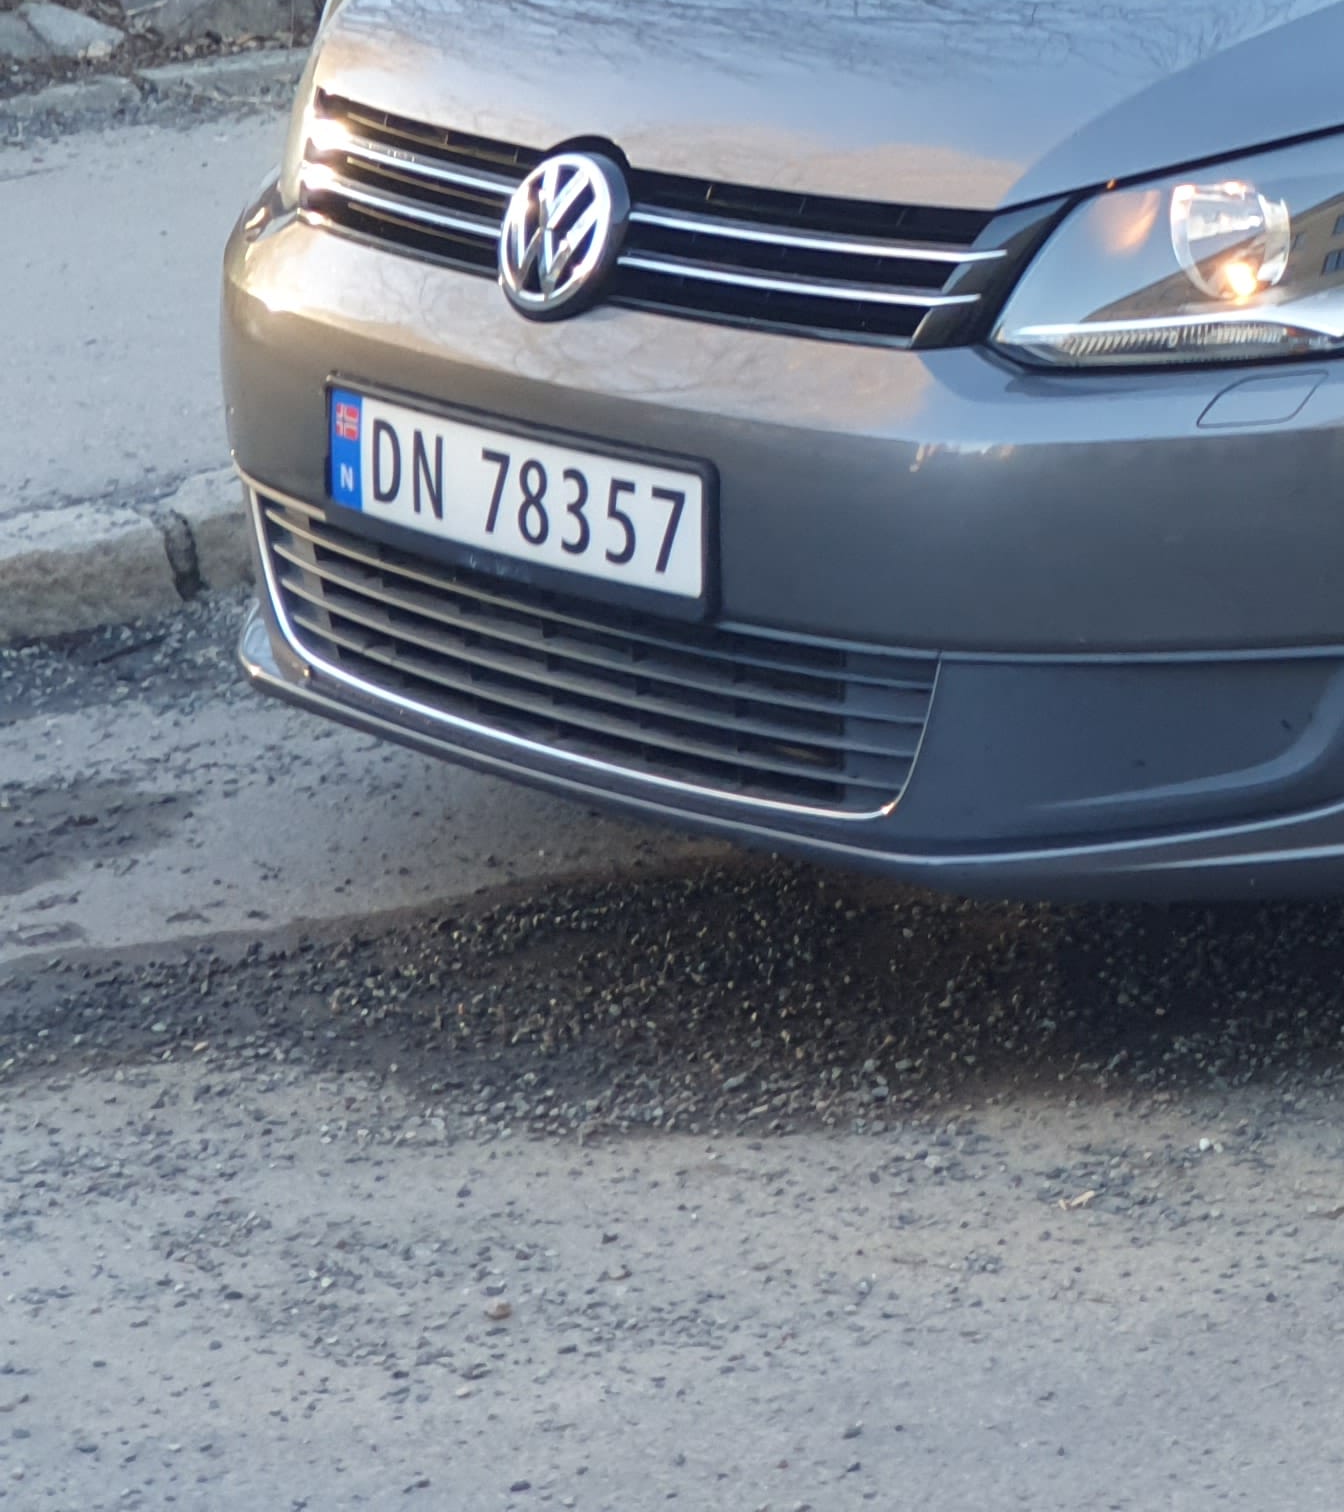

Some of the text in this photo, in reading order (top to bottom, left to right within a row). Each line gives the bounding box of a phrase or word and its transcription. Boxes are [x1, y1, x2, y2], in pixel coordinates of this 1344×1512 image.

[502, 154, 611, 308] VW
[340, 462, 354, 492] N
[373, 418, 686, 574] DN 78357
